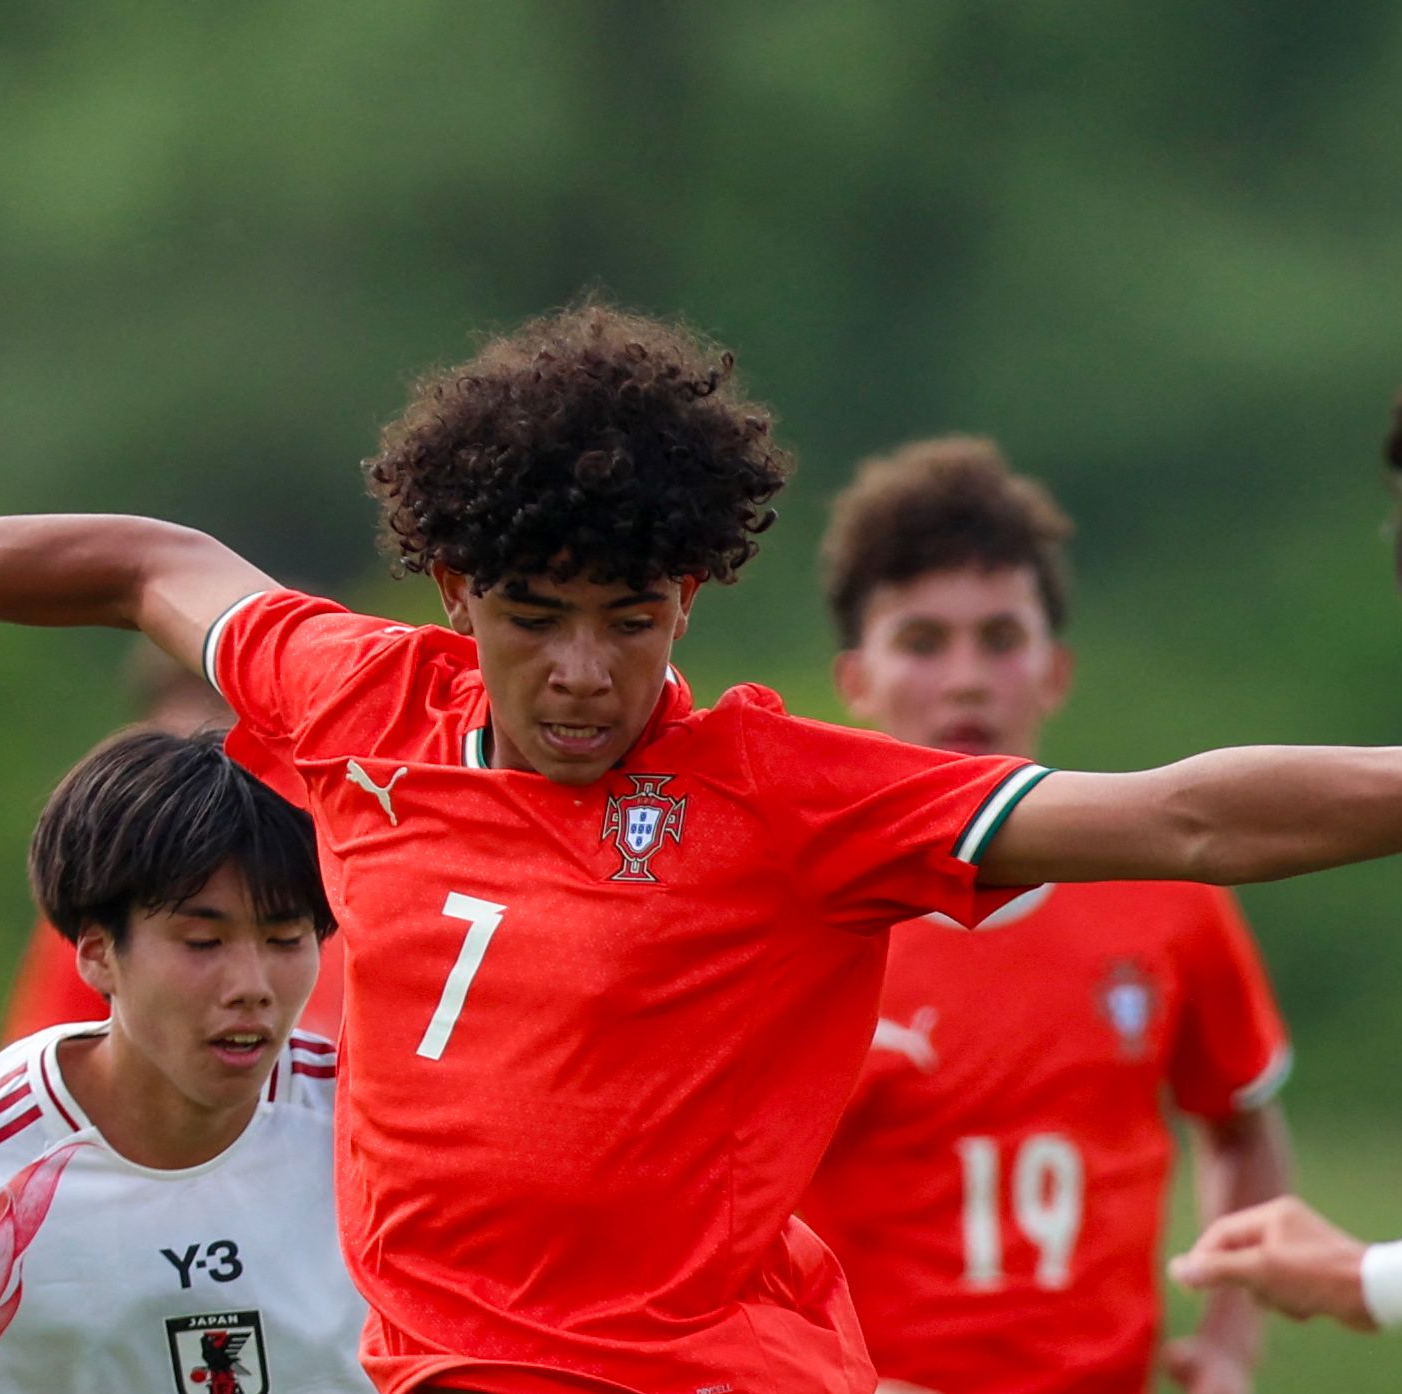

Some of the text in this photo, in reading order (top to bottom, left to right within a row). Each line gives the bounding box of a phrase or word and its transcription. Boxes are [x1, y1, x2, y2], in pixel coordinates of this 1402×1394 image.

[416, 891, 507, 1061] 7
[958, 1131, 1085, 1291] 19
[160, 1239, 244, 1289] Y-3
[188, 1314, 239, 1327] JAPAN
